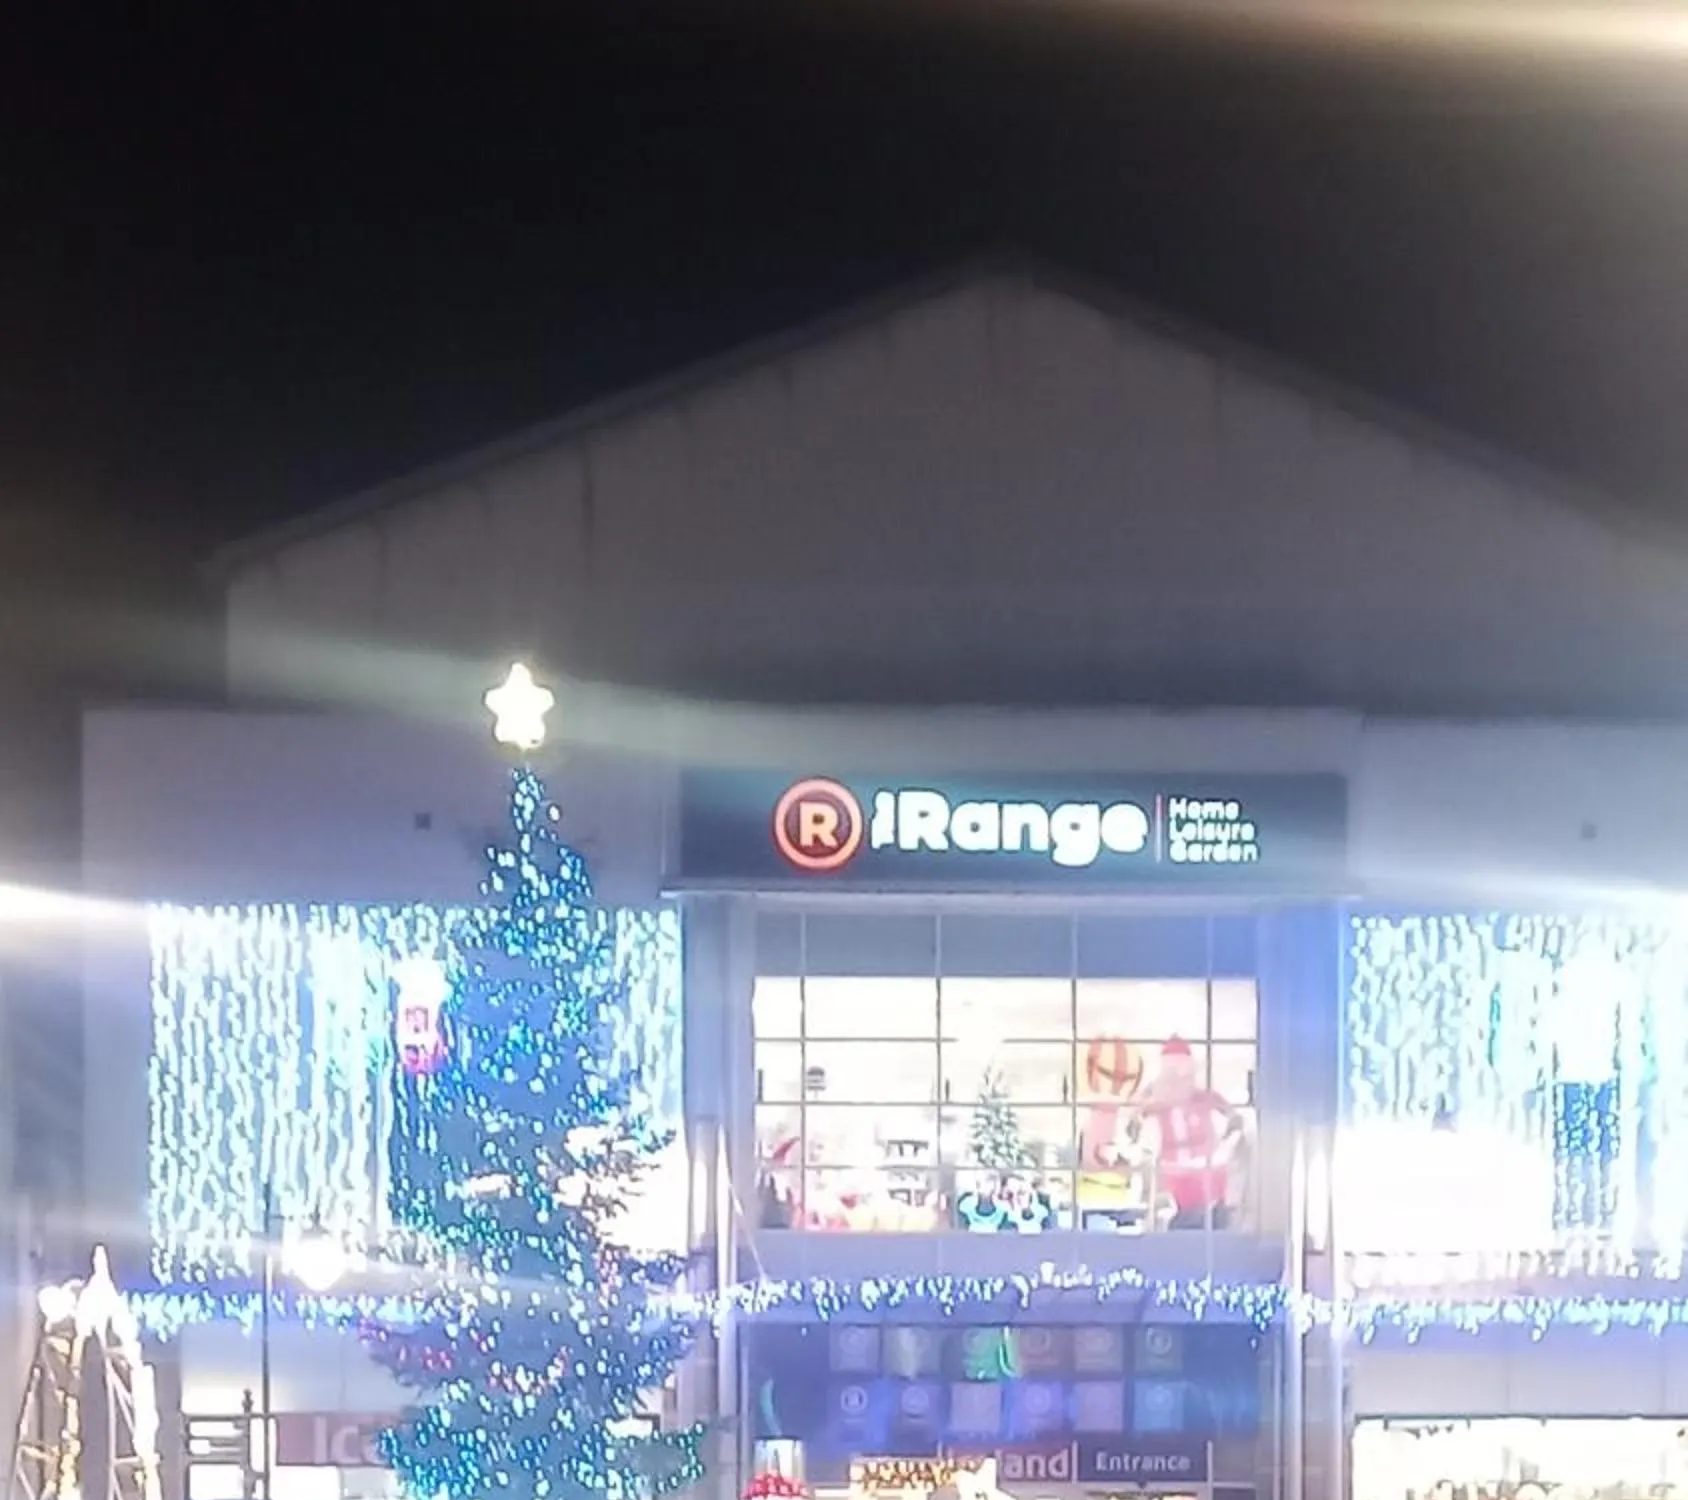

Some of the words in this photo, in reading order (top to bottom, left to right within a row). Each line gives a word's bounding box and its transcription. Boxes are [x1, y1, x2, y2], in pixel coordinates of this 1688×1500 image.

[1169, 797, 1240, 820] Home
[898, 790, 1149, 867] Range
[1169, 818, 1256, 841] Leisure
[1169, 839, 1259, 863] Garden
[1095, 1451, 1192, 1472] Entrance
